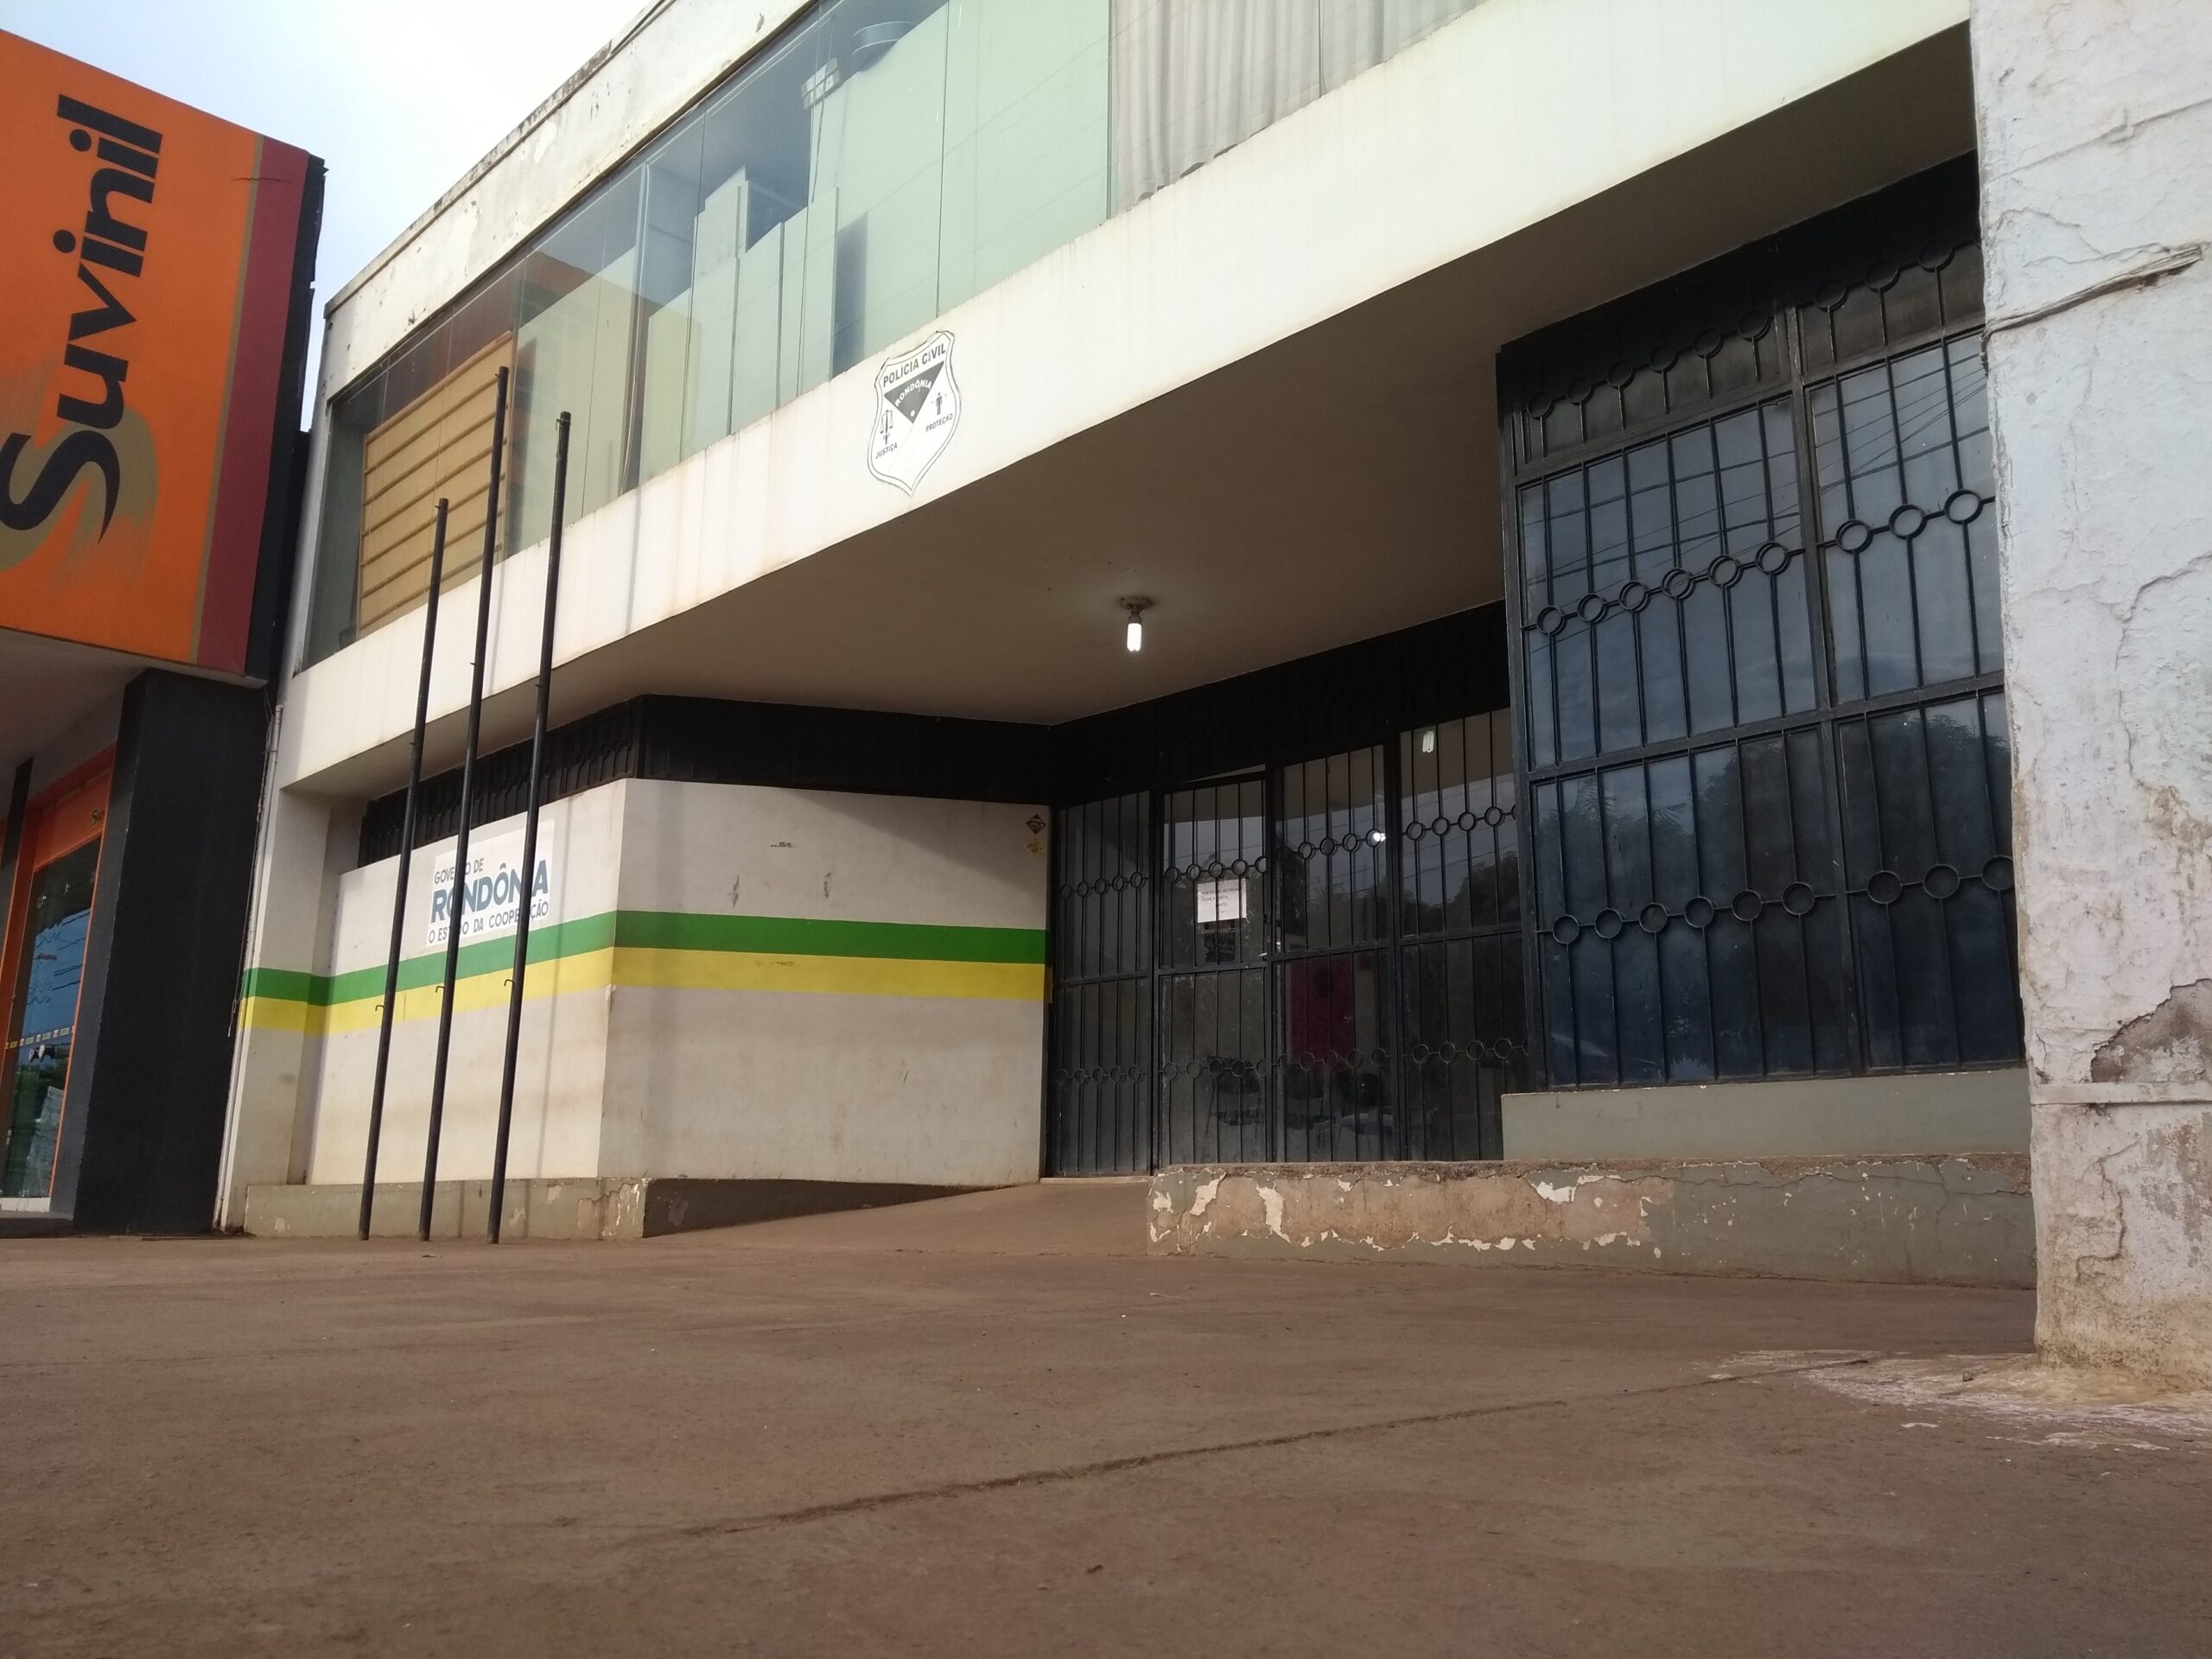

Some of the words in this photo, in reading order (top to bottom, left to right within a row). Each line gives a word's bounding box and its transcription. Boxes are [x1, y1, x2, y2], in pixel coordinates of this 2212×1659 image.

[0, 93, 163, 544] Suvinil
[921, 343, 946, 365] CIVIL
[430, 859, 548, 924] RNDÔNA
[434, 861, 472, 885] GOVEO
[474, 858, 484, 874] DE
[429, 930, 435, 944] O
[438, 921, 469, 942] ESO
[474, 917, 484, 932] DA
[488, 899, 549, 929] COOPEÇÃO
